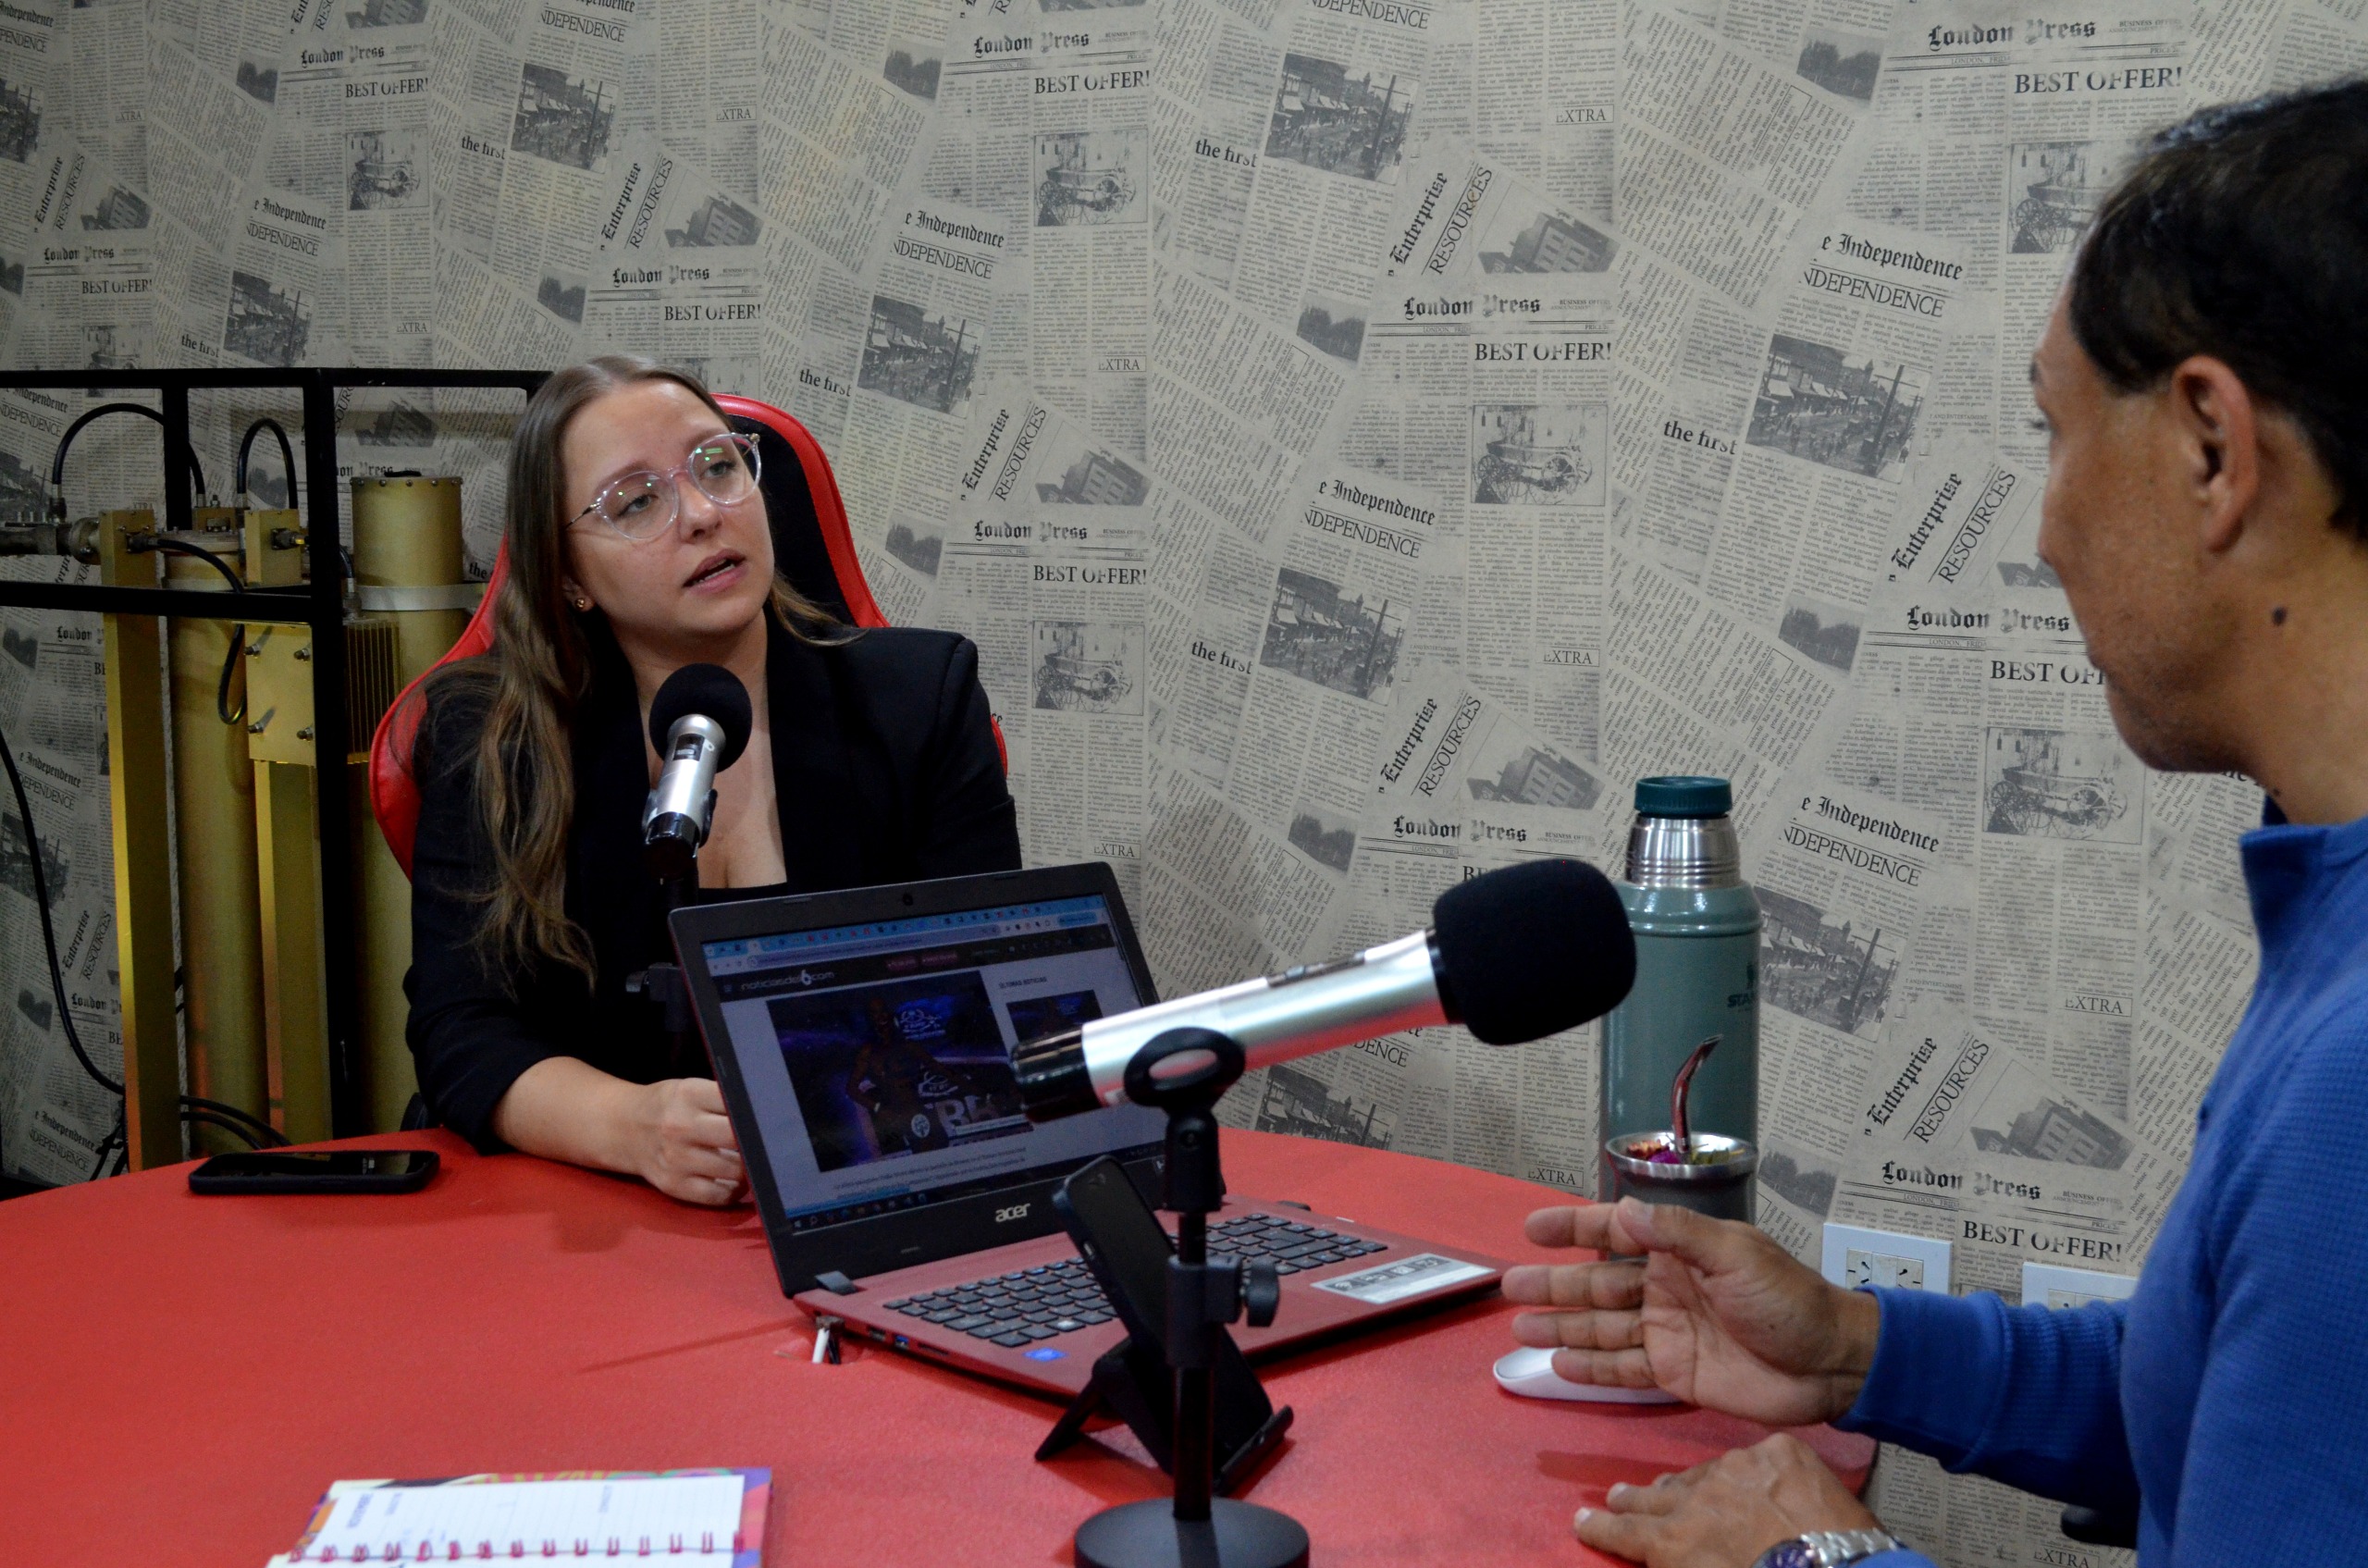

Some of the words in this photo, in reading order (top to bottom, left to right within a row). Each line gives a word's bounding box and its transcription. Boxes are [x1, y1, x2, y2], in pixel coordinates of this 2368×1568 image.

[974, 35, 1033, 58] London
[1929, 24, 2014, 52] London
[2025, 18, 2096, 44] Press
[302, 50, 344, 68] London
[345, 81, 377, 98] BEST
[381, 78, 428, 95] OFFER!
[1034, 76, 1079, 94] BEST
[1084, 70, 1150, 91] OFFER!
[2014, 70, 2079, 94] BEST
[2086, 67, 2182, 91] OFFER!
[462, 136, 479, 153] the
[483, 142, 506, 160] first
[1196, 139, 1220, 158] the
[1225, 146, 1256, 167] first
[56, 154, 85, 230] RESOURCES
[601, 163, 642, 240] Enterprise
[629, 158, 672, 249] RESOURCES
[262, 198, 327, 229] Independence
[1389, 172, 1448, 265] Enterprise
[1429, 167, 1493, 275] RESOURCES
[916, 210, 1005, 249] Independence
[44, 247, 80, 264] London
[1838, 233, 1963, 280] Independence
[82, 280, 110, 294] BEST
[613, 266, 662, 288] London
[664, 304, 703, 321] BEST
[706, 303, 761, 320] OFFER!
[1404, 297, 1474, 321] London
[1483, 294, 1541, 318] Press
[181, 334, 197, 350] the
[1474, 343, 1527, 361] BEST
[1534, 342, 1611, 361] OFFER!
[799, 368, 820, 389] the
[824, 376, 852, 398] first
[961, 409, 1010, 490] Enterprise
[1664, 420, 1694, 442] the
[1696, 429, 1737, 455] first
[994, 406, 1047, 502] RESOURCES
[1331, 479, 1436, 526] Independence
[975, 519, 1032, 542] London
[1891, 473, 1962, 570] Enterprise
[1938, 470, 2016, 584] RESOURCES
[469, 562, 487, 578] the
[1034, 565, 1078, 583] BEST
[1082, 566, 1147, 586] OFFER!
[1906, 605, 1990, 631] London
[2000, 608, 2070, 634] Press
[1191, 641, 1216, 662] the
[1219, 652, 1252, 675] first
[1991, 660, 2054, 682] BEST
[1380, 698, 1438, 784] Enterprise
[1419, 696, 1482, 797] RESOURCES
[1394, 815, 1462, 839] London
[1816, 796, 1940, 853] Independence
[1867, 1037, 1938, 1127] Enterprise
[1913, 1039, 1990, 1143] RESOURCES
[1881, 1160, 1964, 1191] London
[1973, 1171, 2041, 1201] Press
[995, 1203, 1030, 1222] acer
[1963, 1220, 2025, 1247] BEST
[2030, 1231, 2122, 1263] OFFER!
